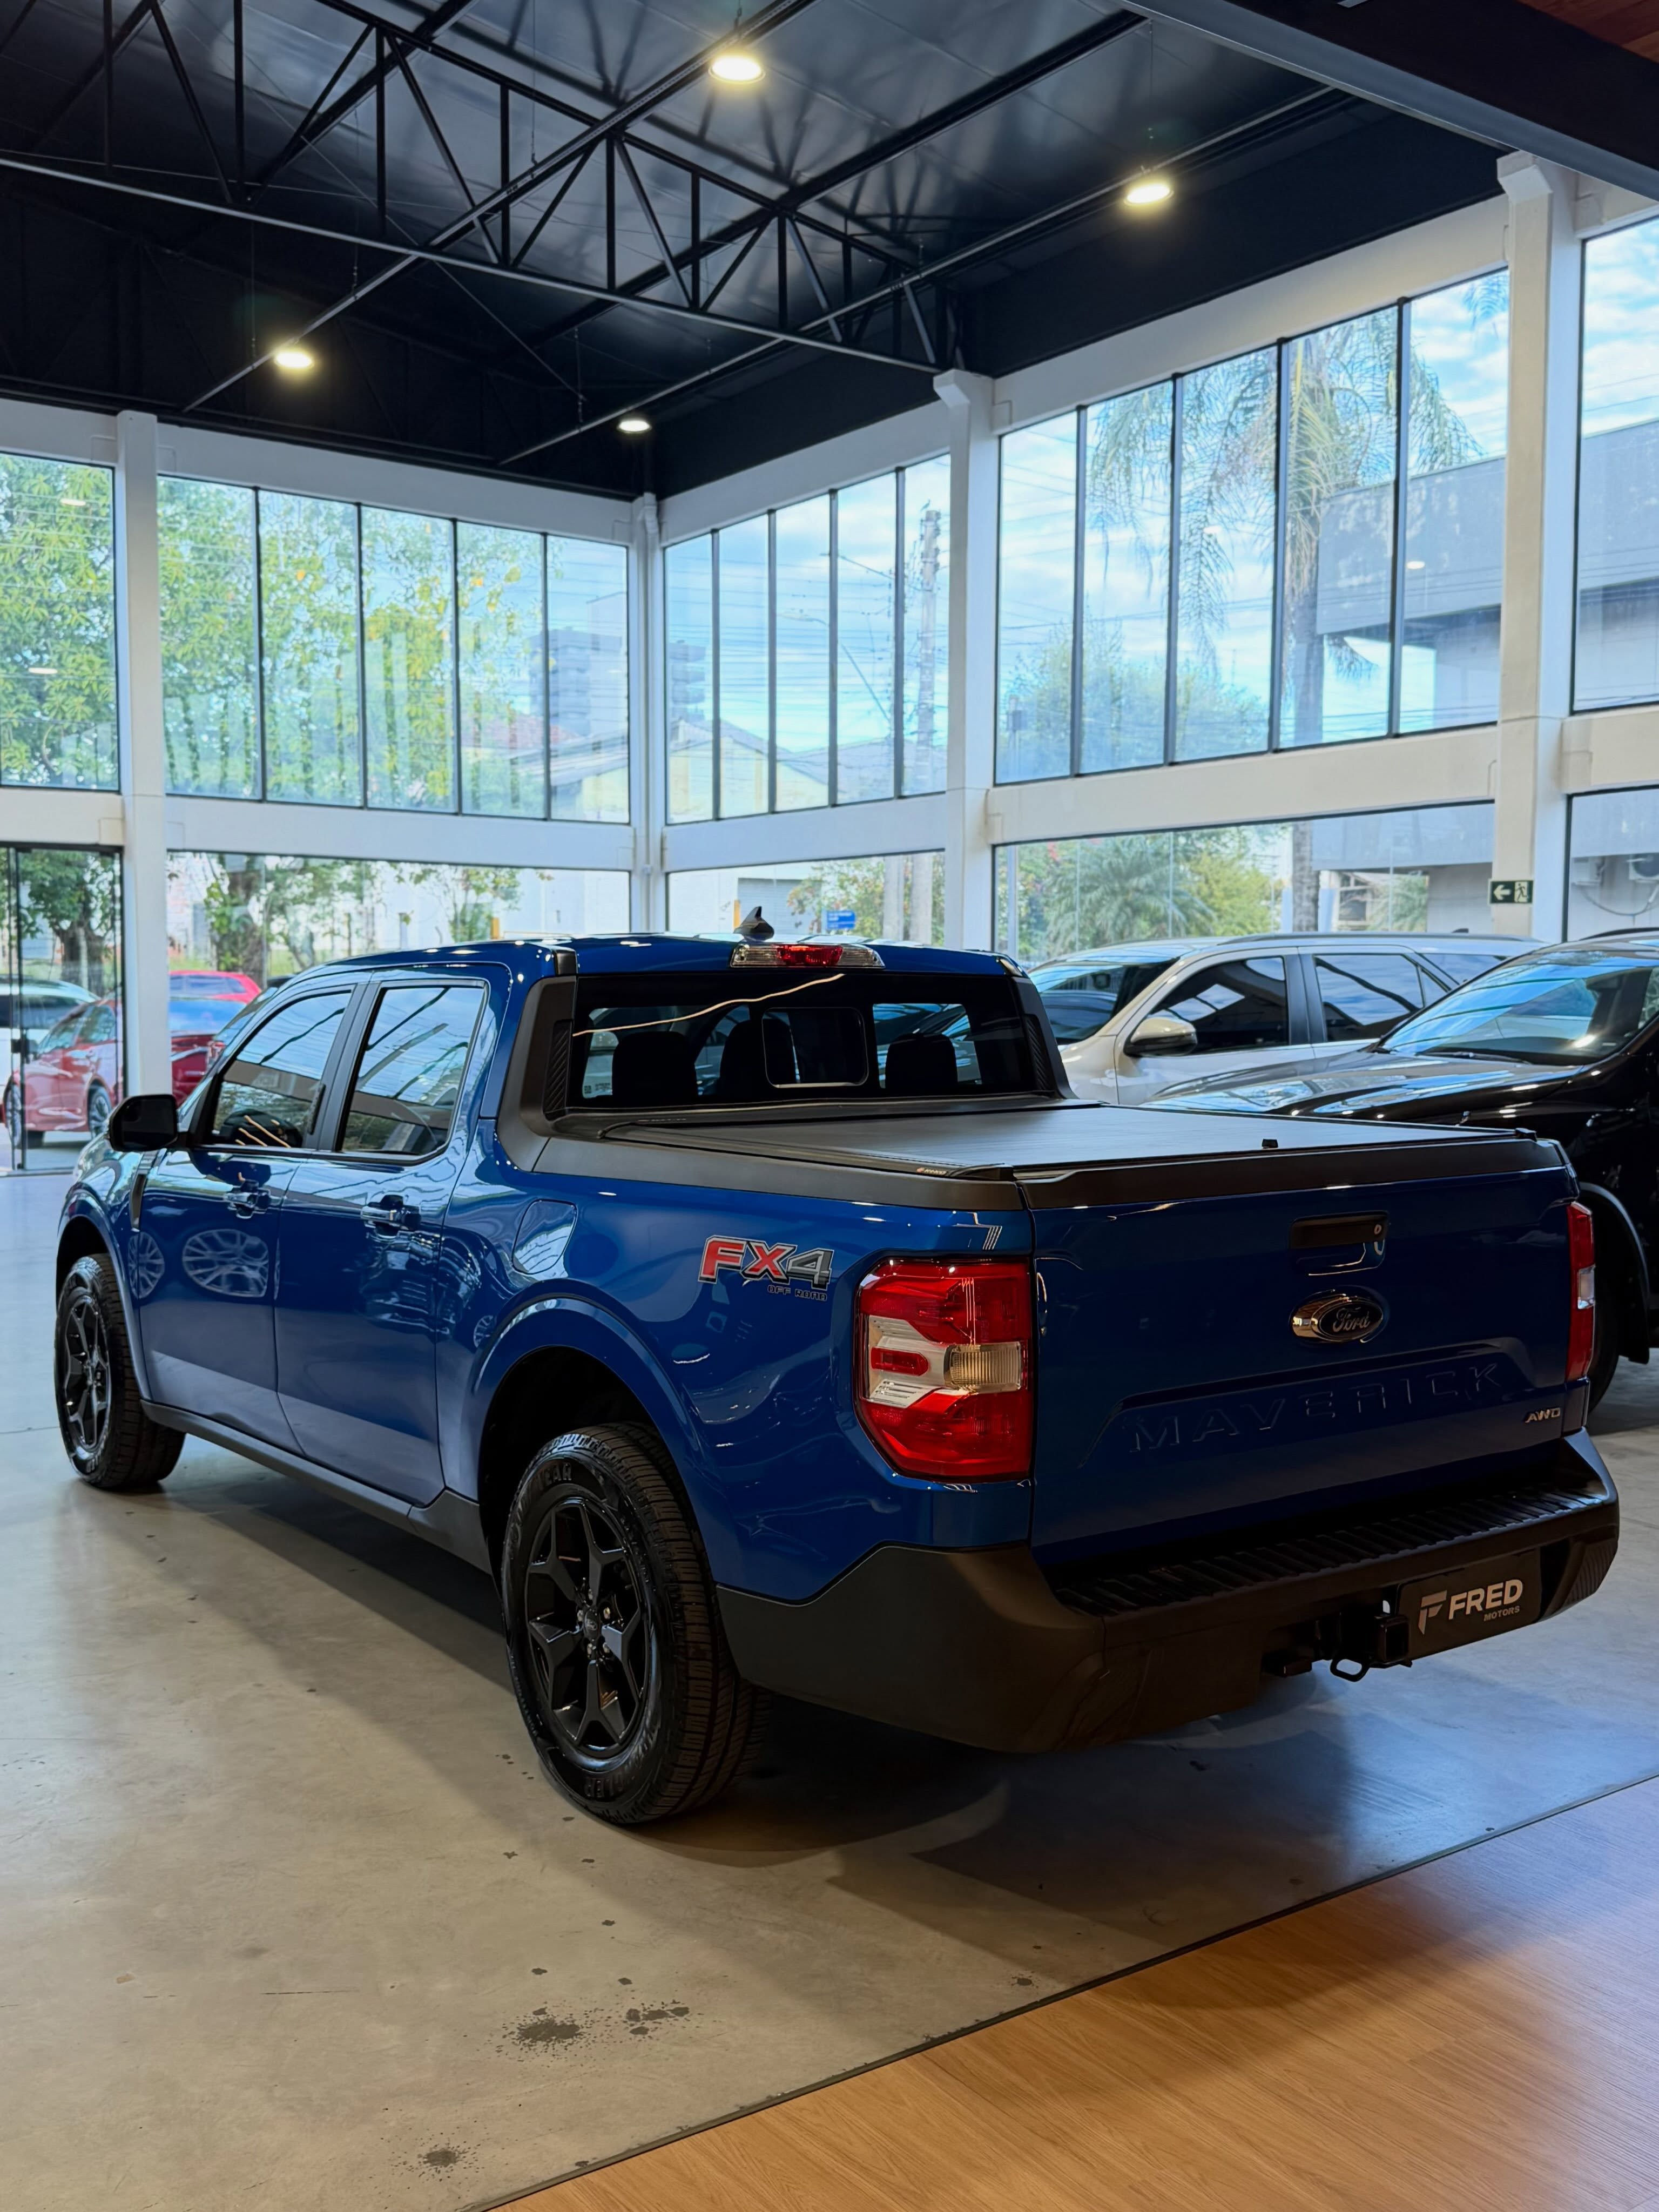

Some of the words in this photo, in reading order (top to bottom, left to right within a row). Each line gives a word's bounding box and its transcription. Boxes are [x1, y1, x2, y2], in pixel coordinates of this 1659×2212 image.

[698, 1235, 834, 1291] FX4
[767, 1285, 791, 1295] OFF
[794, 1289, 828, 1301] ROAD
[1332, 1306, 1371, 1333] Ford
[1123, 1362, 1503, 1453] MAVERICK
[1525, 1407, 1561, 1424] AWD
[1448, 1579, 1523, 1620] FRED
[1483, 1606, 1520, 1621] MOTORS
